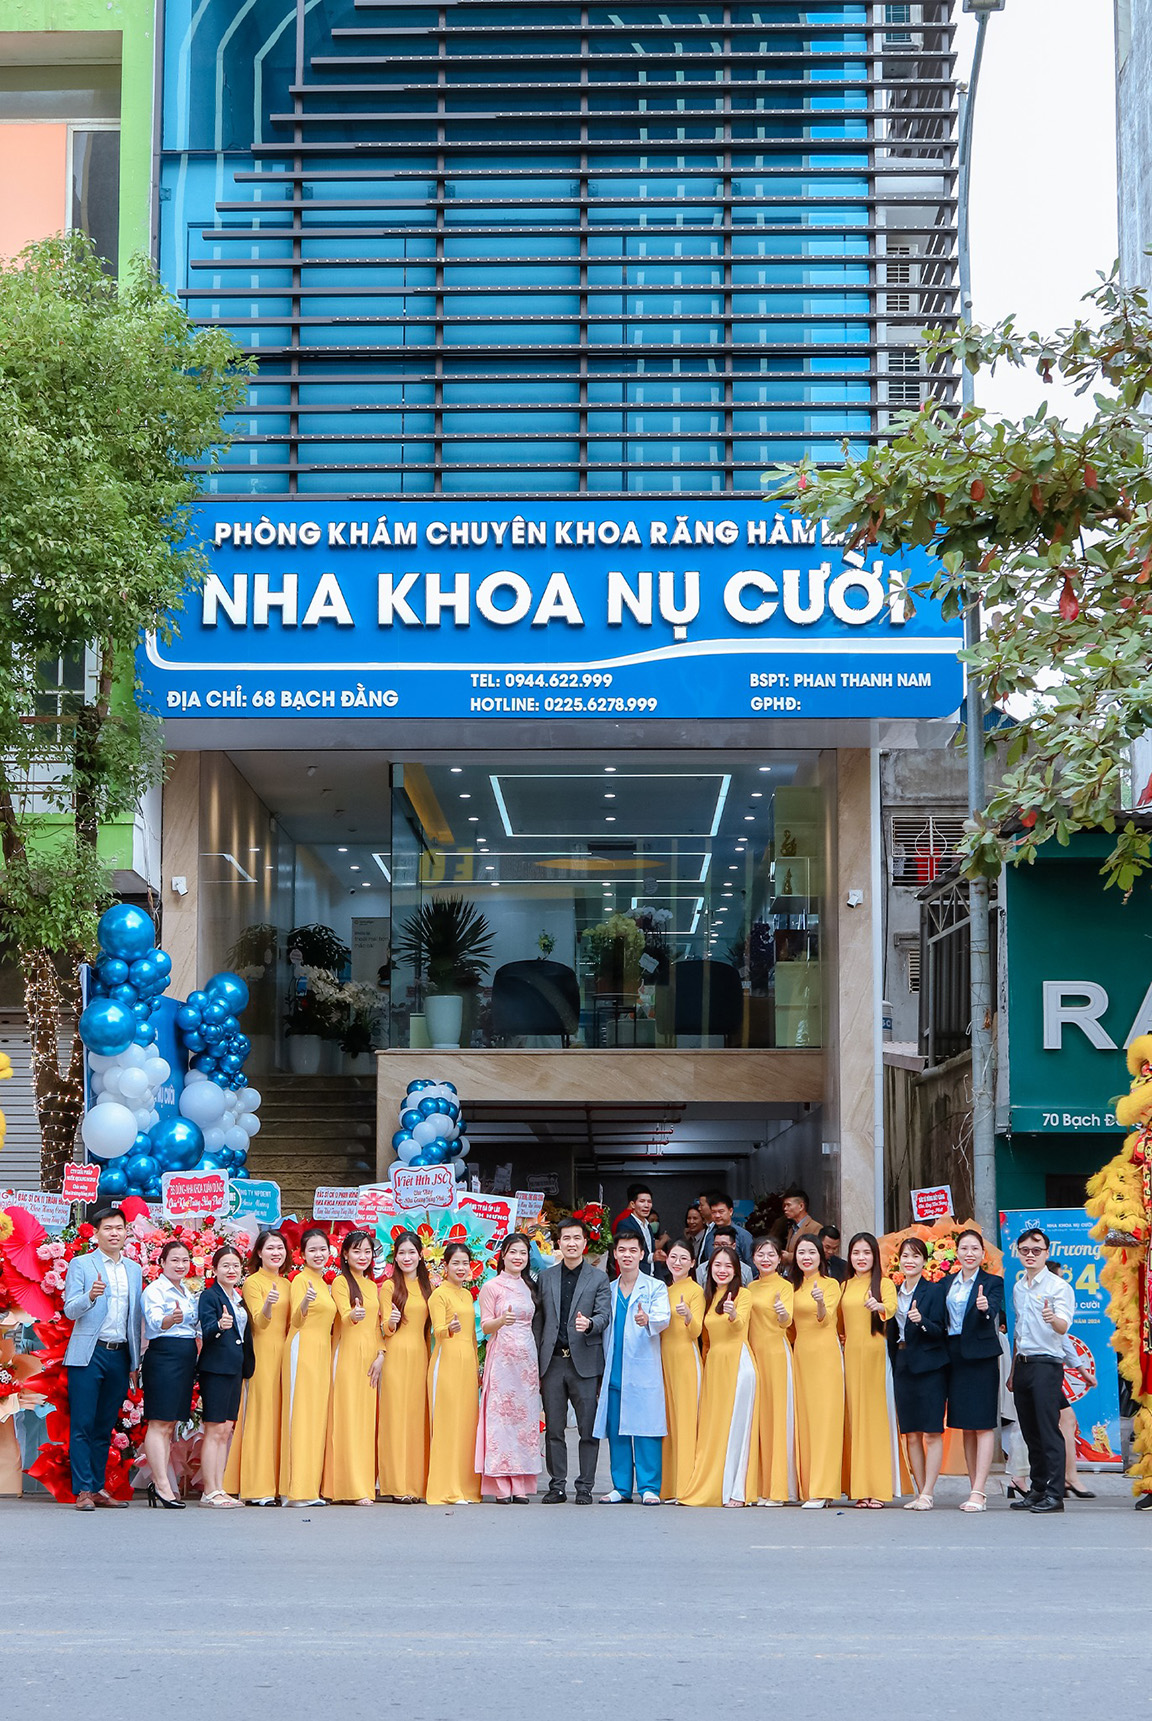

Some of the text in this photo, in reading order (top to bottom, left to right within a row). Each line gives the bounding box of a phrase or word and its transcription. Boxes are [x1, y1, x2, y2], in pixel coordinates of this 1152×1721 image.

[215, 516, 322, 546] PHÒNG
[328, 516, 417, 546] KHÁM
[426, 516, 546, 546] CHUYÊN
[555, 521, 641, 545] KHOA
[650, 515, 739, 545] RĂNG
[747, 512, 815, 545] HÀM
[201, 551, 907, 640] NHA KHOA NỤ CƯỜI
[471, 674, 613, 688] TEL: 0944.622.999
[750, 673, 931, 688] BSPT: PHAN THANH NAM
[167, 683, 399, 712] ĐỊA CHỈ: 68 BẠCH ĐẰNG
[471, 697, 658, 712] HOTLINE: 0225.6278.999
[750, 697, 801, 711] GPHĐ:
[1042, 1113, 1059, 1126] 70
[1063, 1113, 1100, 1130] Bạch
[398, 1172, 448, 1190] Việt Hth JSC
[1075, 1263, 1100, 1295] 4
[1080, 1300, 1101, 1309] CƯỜI
